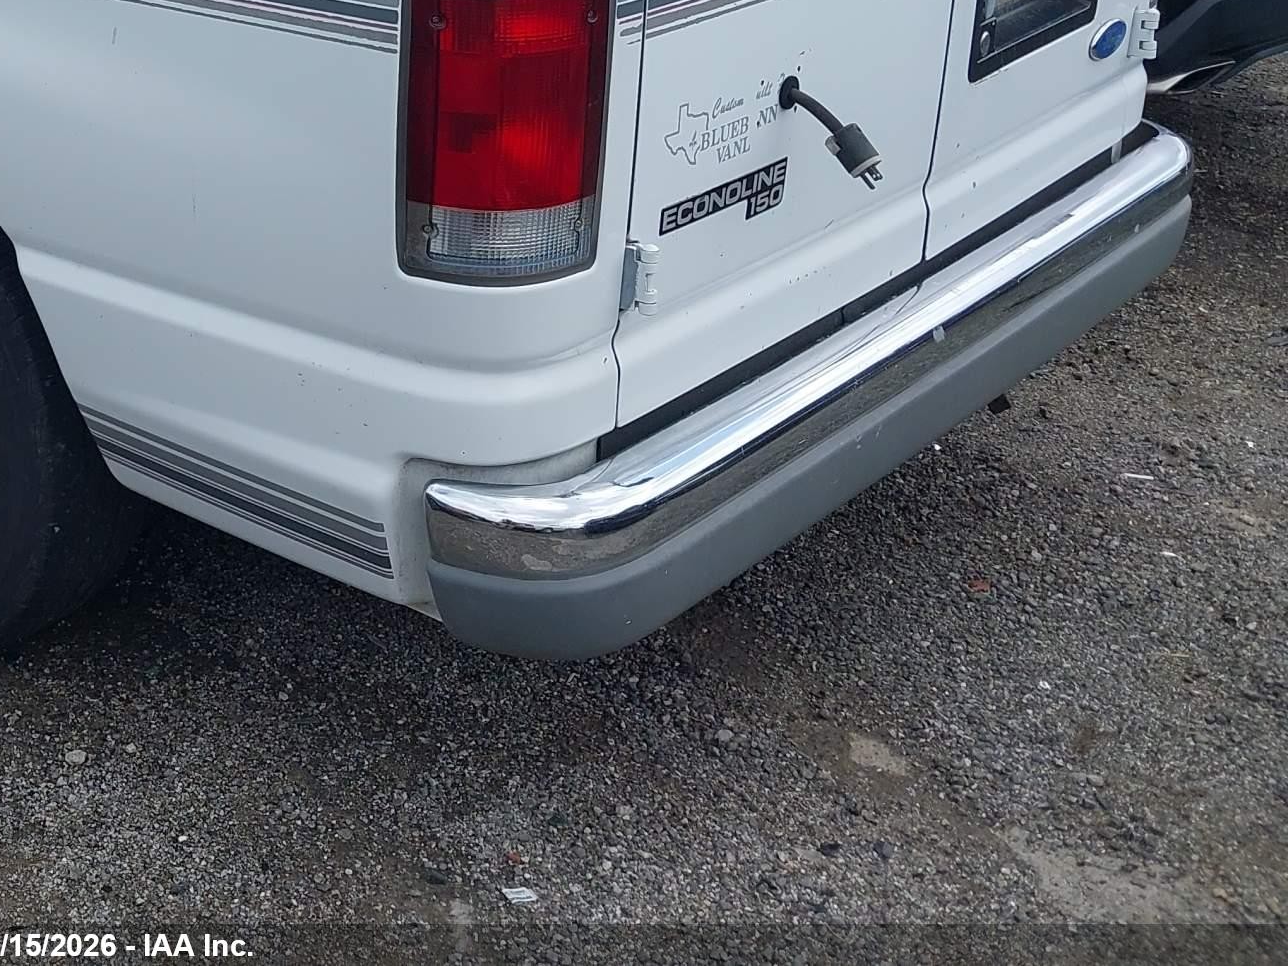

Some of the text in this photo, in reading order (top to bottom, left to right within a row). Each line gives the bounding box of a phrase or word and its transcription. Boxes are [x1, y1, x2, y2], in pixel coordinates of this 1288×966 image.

[711, 97, 745, 120] Custom
[716, 136, 751, 165] VANL
[661, 160, 788, 233] ECONOLINE
[749, 183, 785, 217] 150
